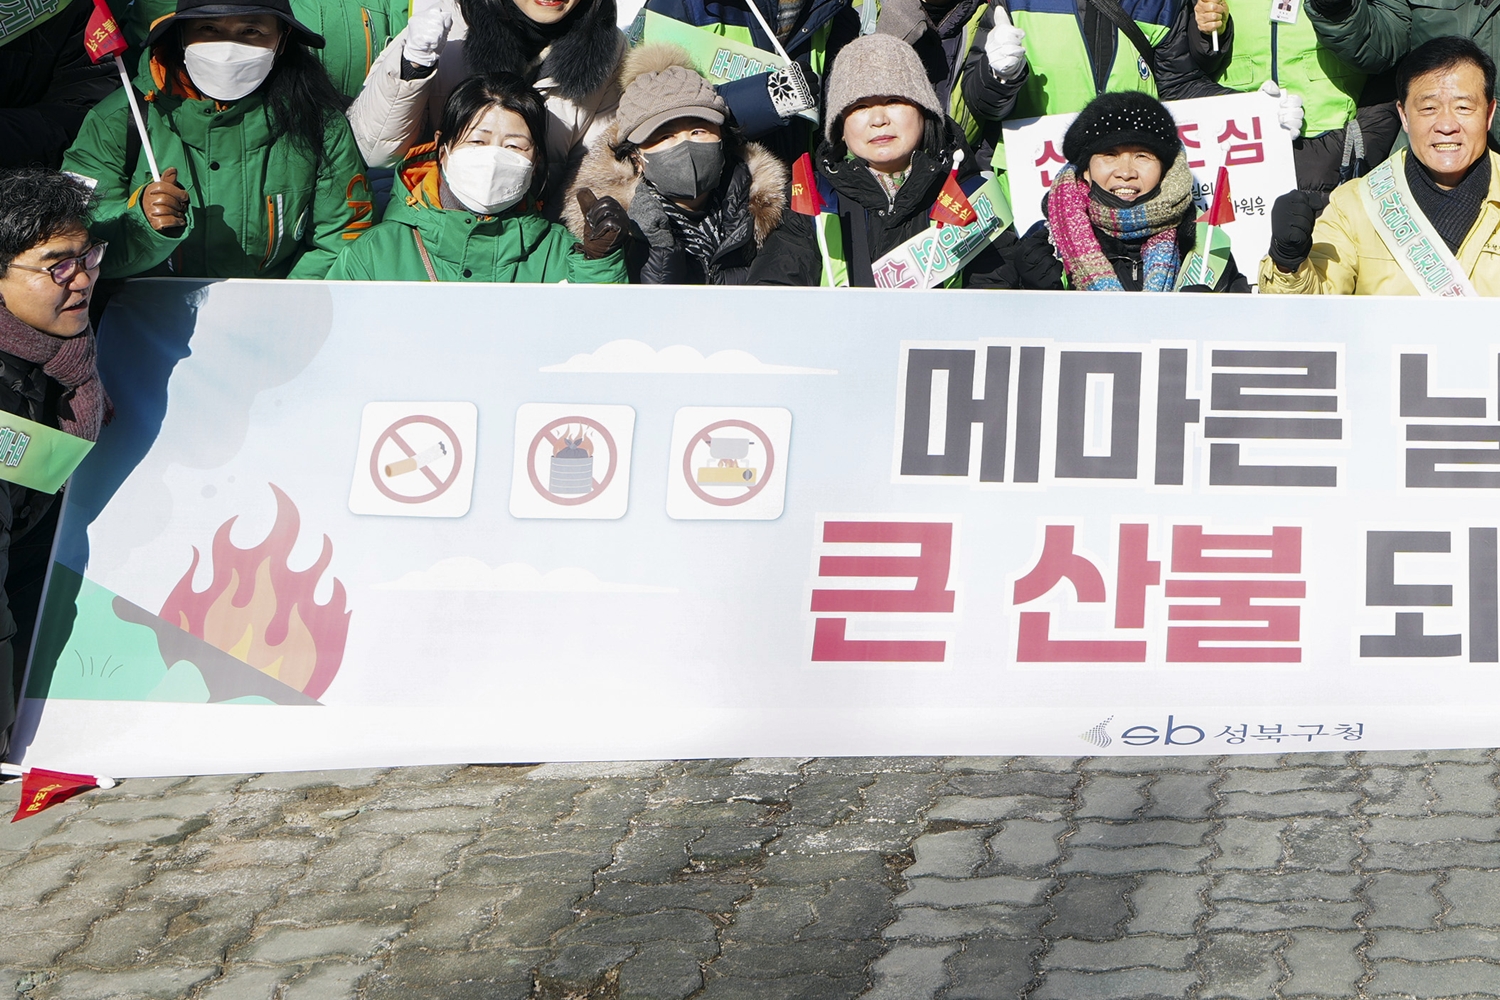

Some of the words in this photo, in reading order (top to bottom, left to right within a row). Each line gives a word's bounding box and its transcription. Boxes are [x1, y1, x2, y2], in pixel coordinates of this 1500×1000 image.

[1378, 191, 1421, 247] 사랑의
[1406, 236, 1454, 292] 실천은
[899, 344, 1343, 487] 메마른
[810, 521, 955, 663] 큰
[1011, 521, 1306, 663] 산불
[1121, 715, 1205, 746] sb
[1213, 722, 1364, 745] 성북구청
